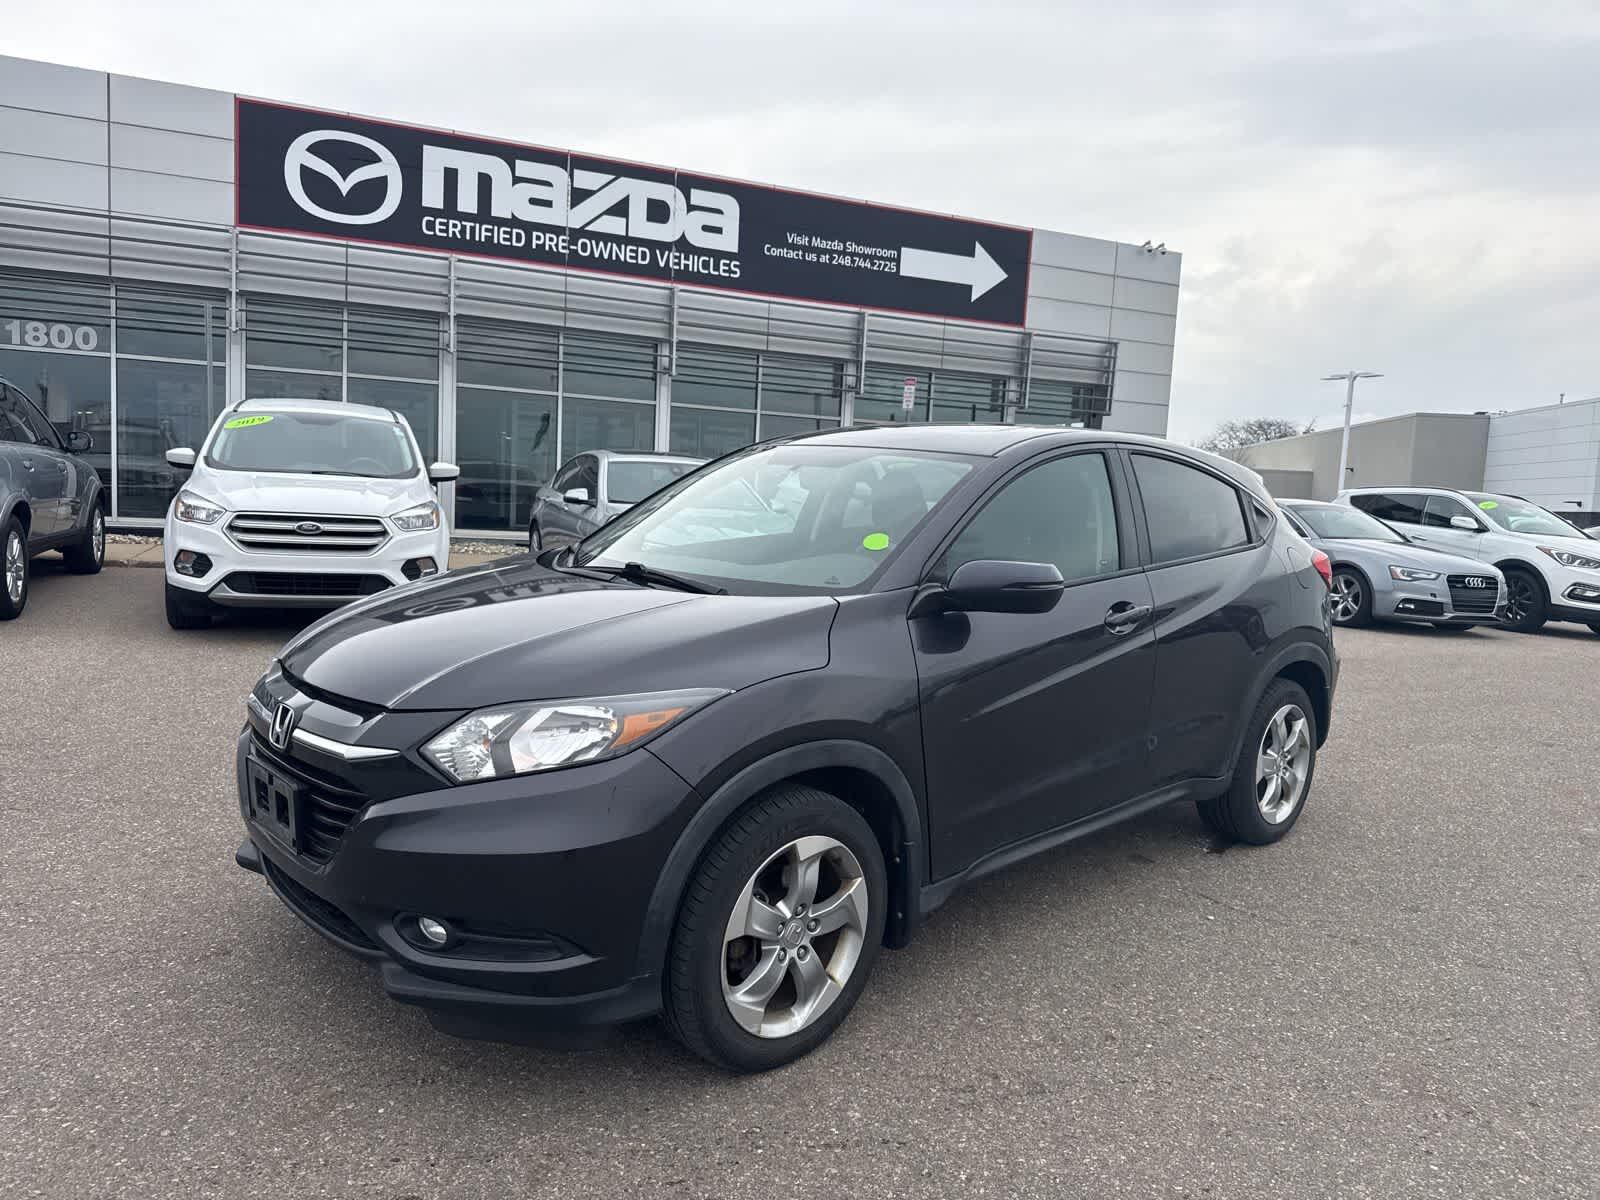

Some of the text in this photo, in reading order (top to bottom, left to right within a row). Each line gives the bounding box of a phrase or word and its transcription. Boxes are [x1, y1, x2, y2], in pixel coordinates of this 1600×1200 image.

[421, 215, 741, 279] CERTIFIED PRE-OWNED VEHICLES
[764, 244, 898, 273] Contact us at 248.744.2725
[787, 232, 898, 259] Visit Mazda Showroom
[4, 319, 98, 351] 1800
